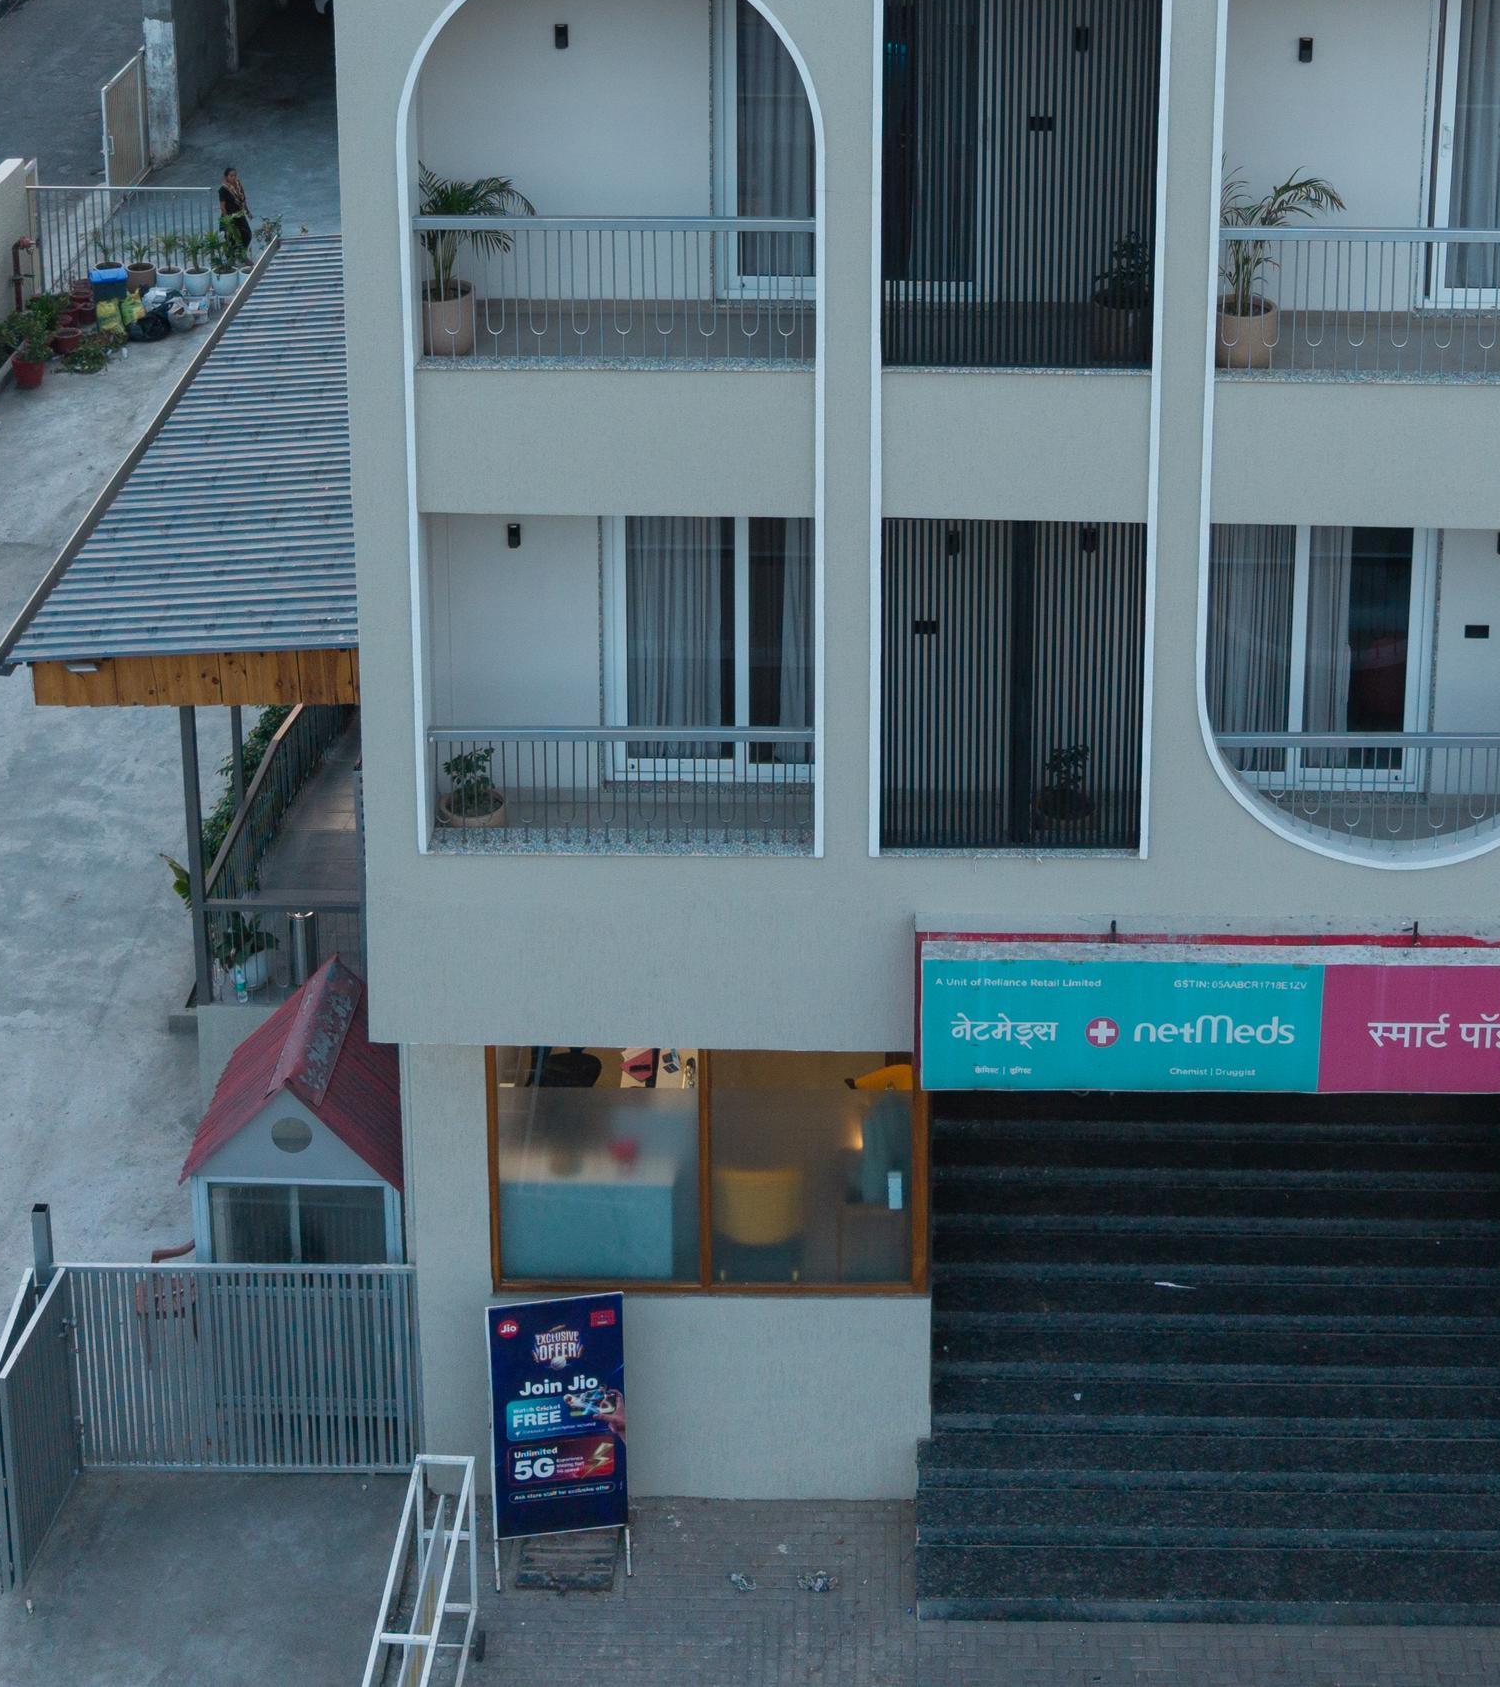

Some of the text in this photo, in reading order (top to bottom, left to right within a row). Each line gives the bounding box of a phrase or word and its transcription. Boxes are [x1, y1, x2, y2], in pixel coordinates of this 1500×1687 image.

[935, 977, 1102, 988] A Unit of Reliance Retail Limited
[1173, 979, 1210, 989] GSTIN:
[951, 1013, 1059, 1049] नेटमेड्स
[1134, 1015, 1295, 1044] netMeds
[1367, 1013, 1450, 1048] स्मार्ट
[1169, 1067, 1256, 1077] Chemist Druggist
[500, 1323, 517, 1334] Jio
[535, 1331, 580, 1346] EXCLUSIVE
[540, 1341, 578, 1361] OFFER
[519, 1374, 598, 1396] Join Jio
[513, 1410, 562, 1428] FREE
[514, 1447, 558, 1459] Unlimited
[514, 1457, 555, 1480] 5G
